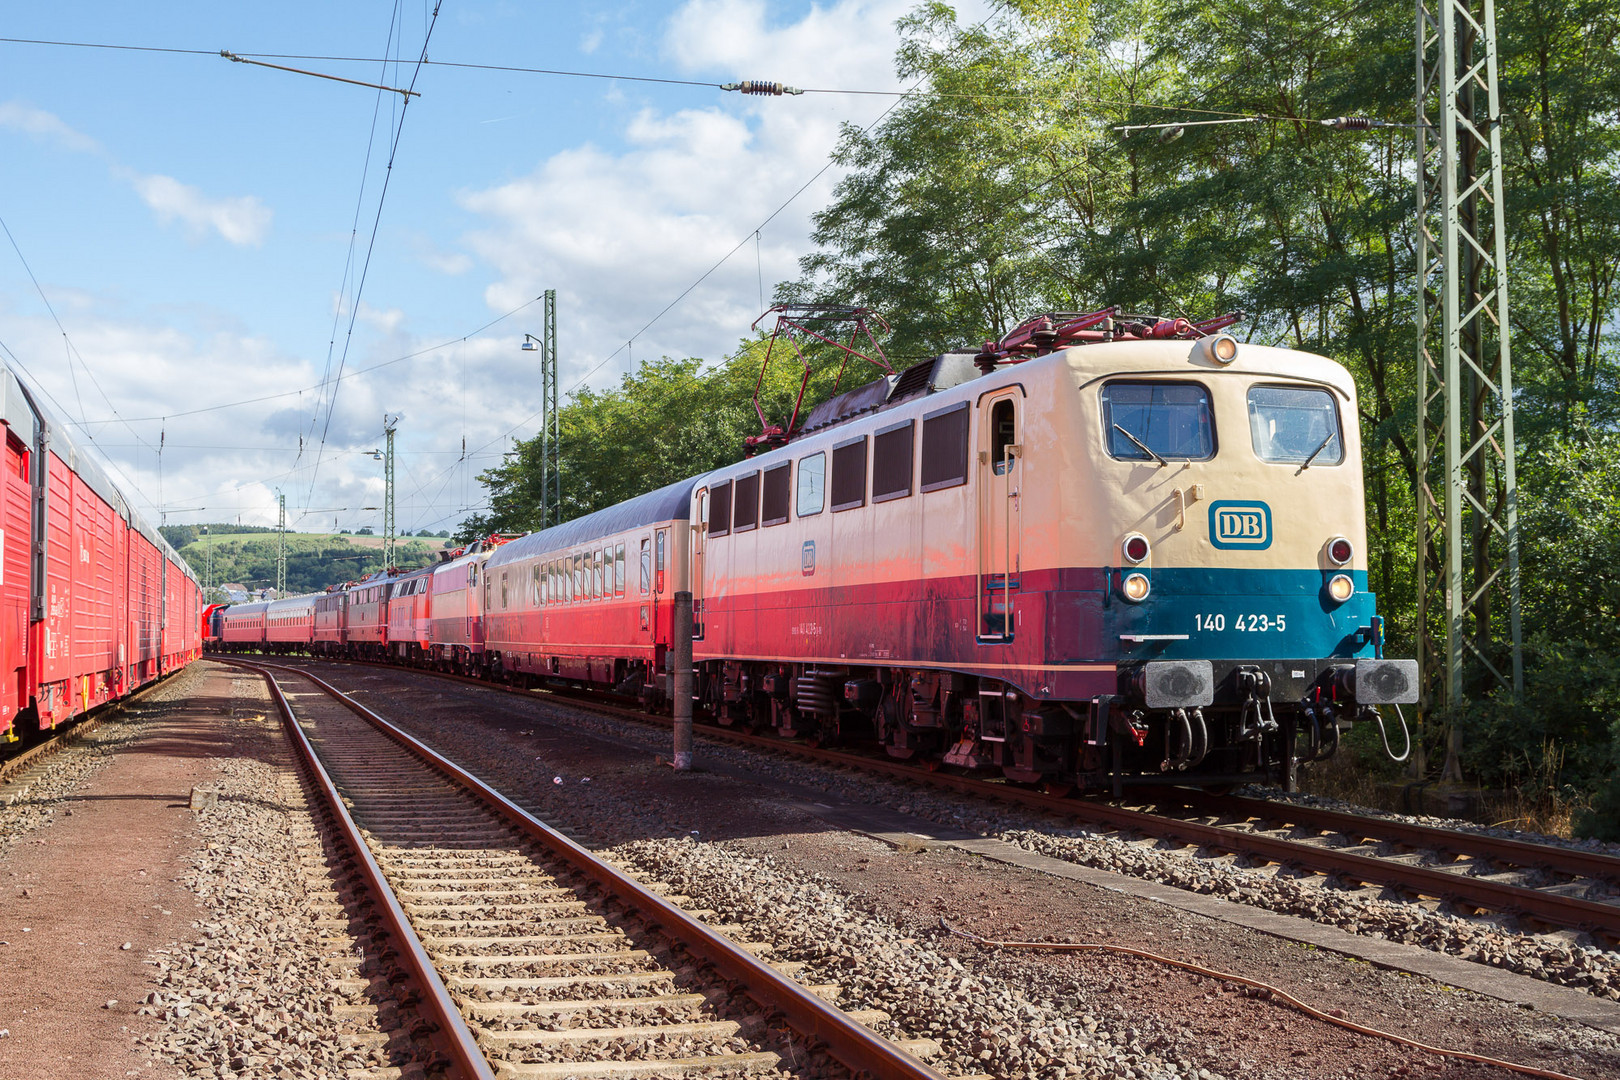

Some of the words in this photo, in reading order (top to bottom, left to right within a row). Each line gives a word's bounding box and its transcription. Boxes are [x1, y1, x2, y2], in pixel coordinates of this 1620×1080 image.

[1221, 514, 1260, 536] DB
[1195, 614, 1225, 631] 140
[1235, 614, 1286, 632] 423-5
